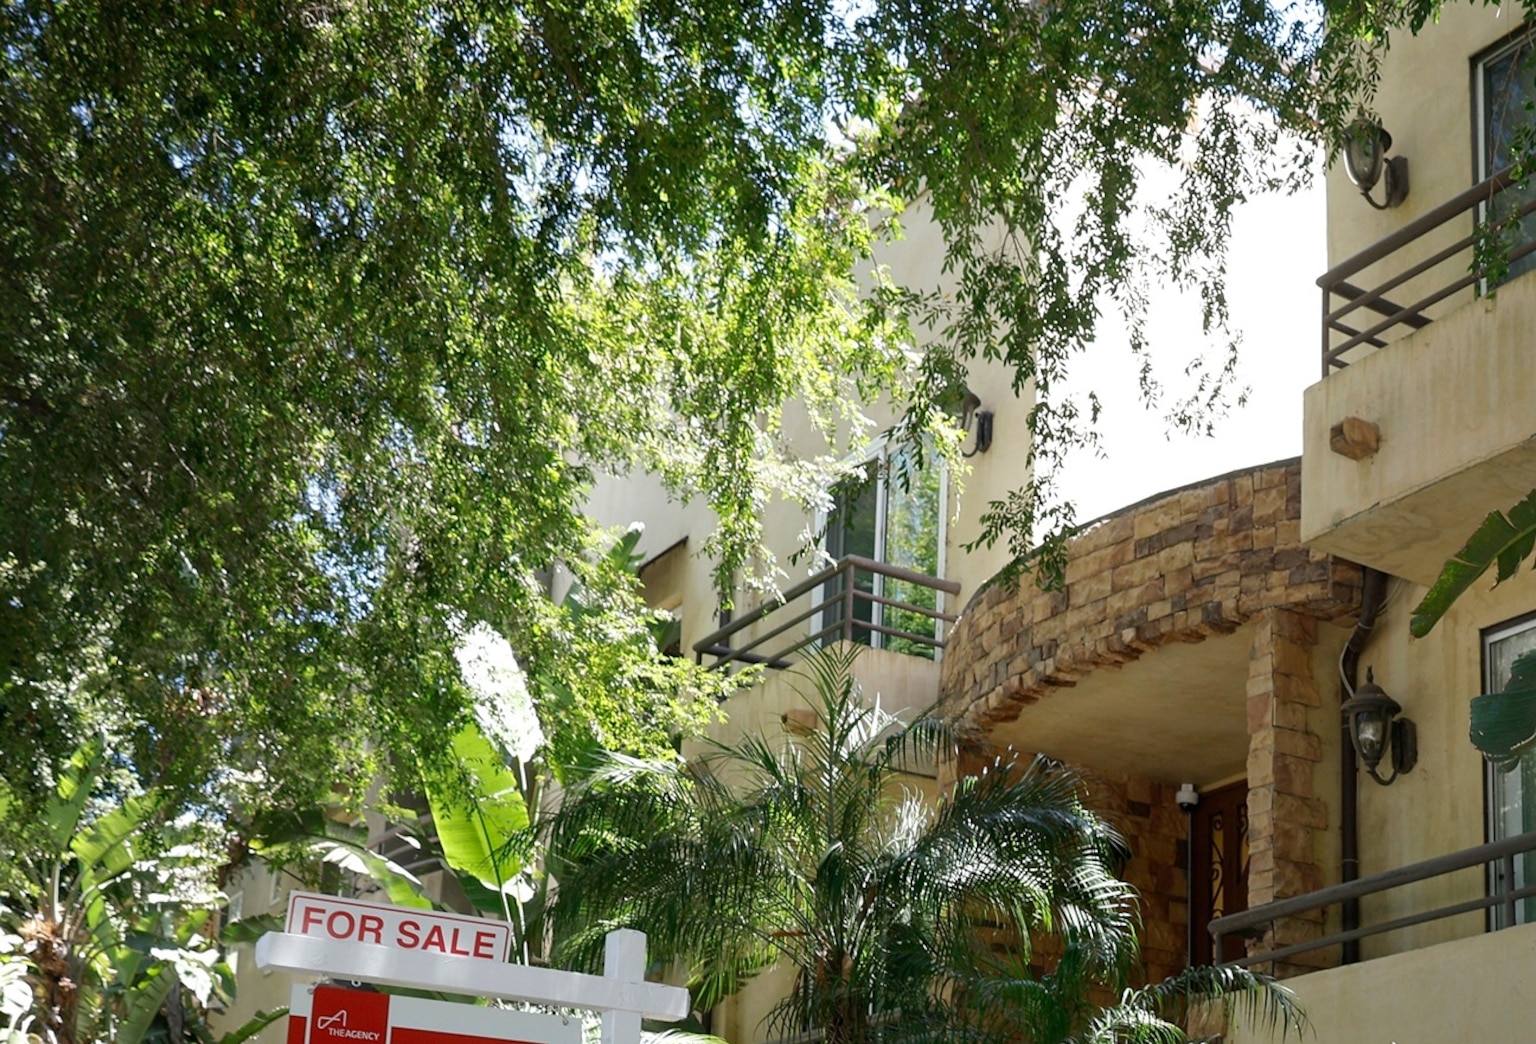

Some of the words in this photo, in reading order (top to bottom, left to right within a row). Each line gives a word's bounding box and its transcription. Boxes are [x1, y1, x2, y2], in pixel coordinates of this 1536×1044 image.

[301, 906, 385, 945] FOR
[396, 920, 497, 960] SALE
[328, 1027, 381, 1041] THEAGENCY
